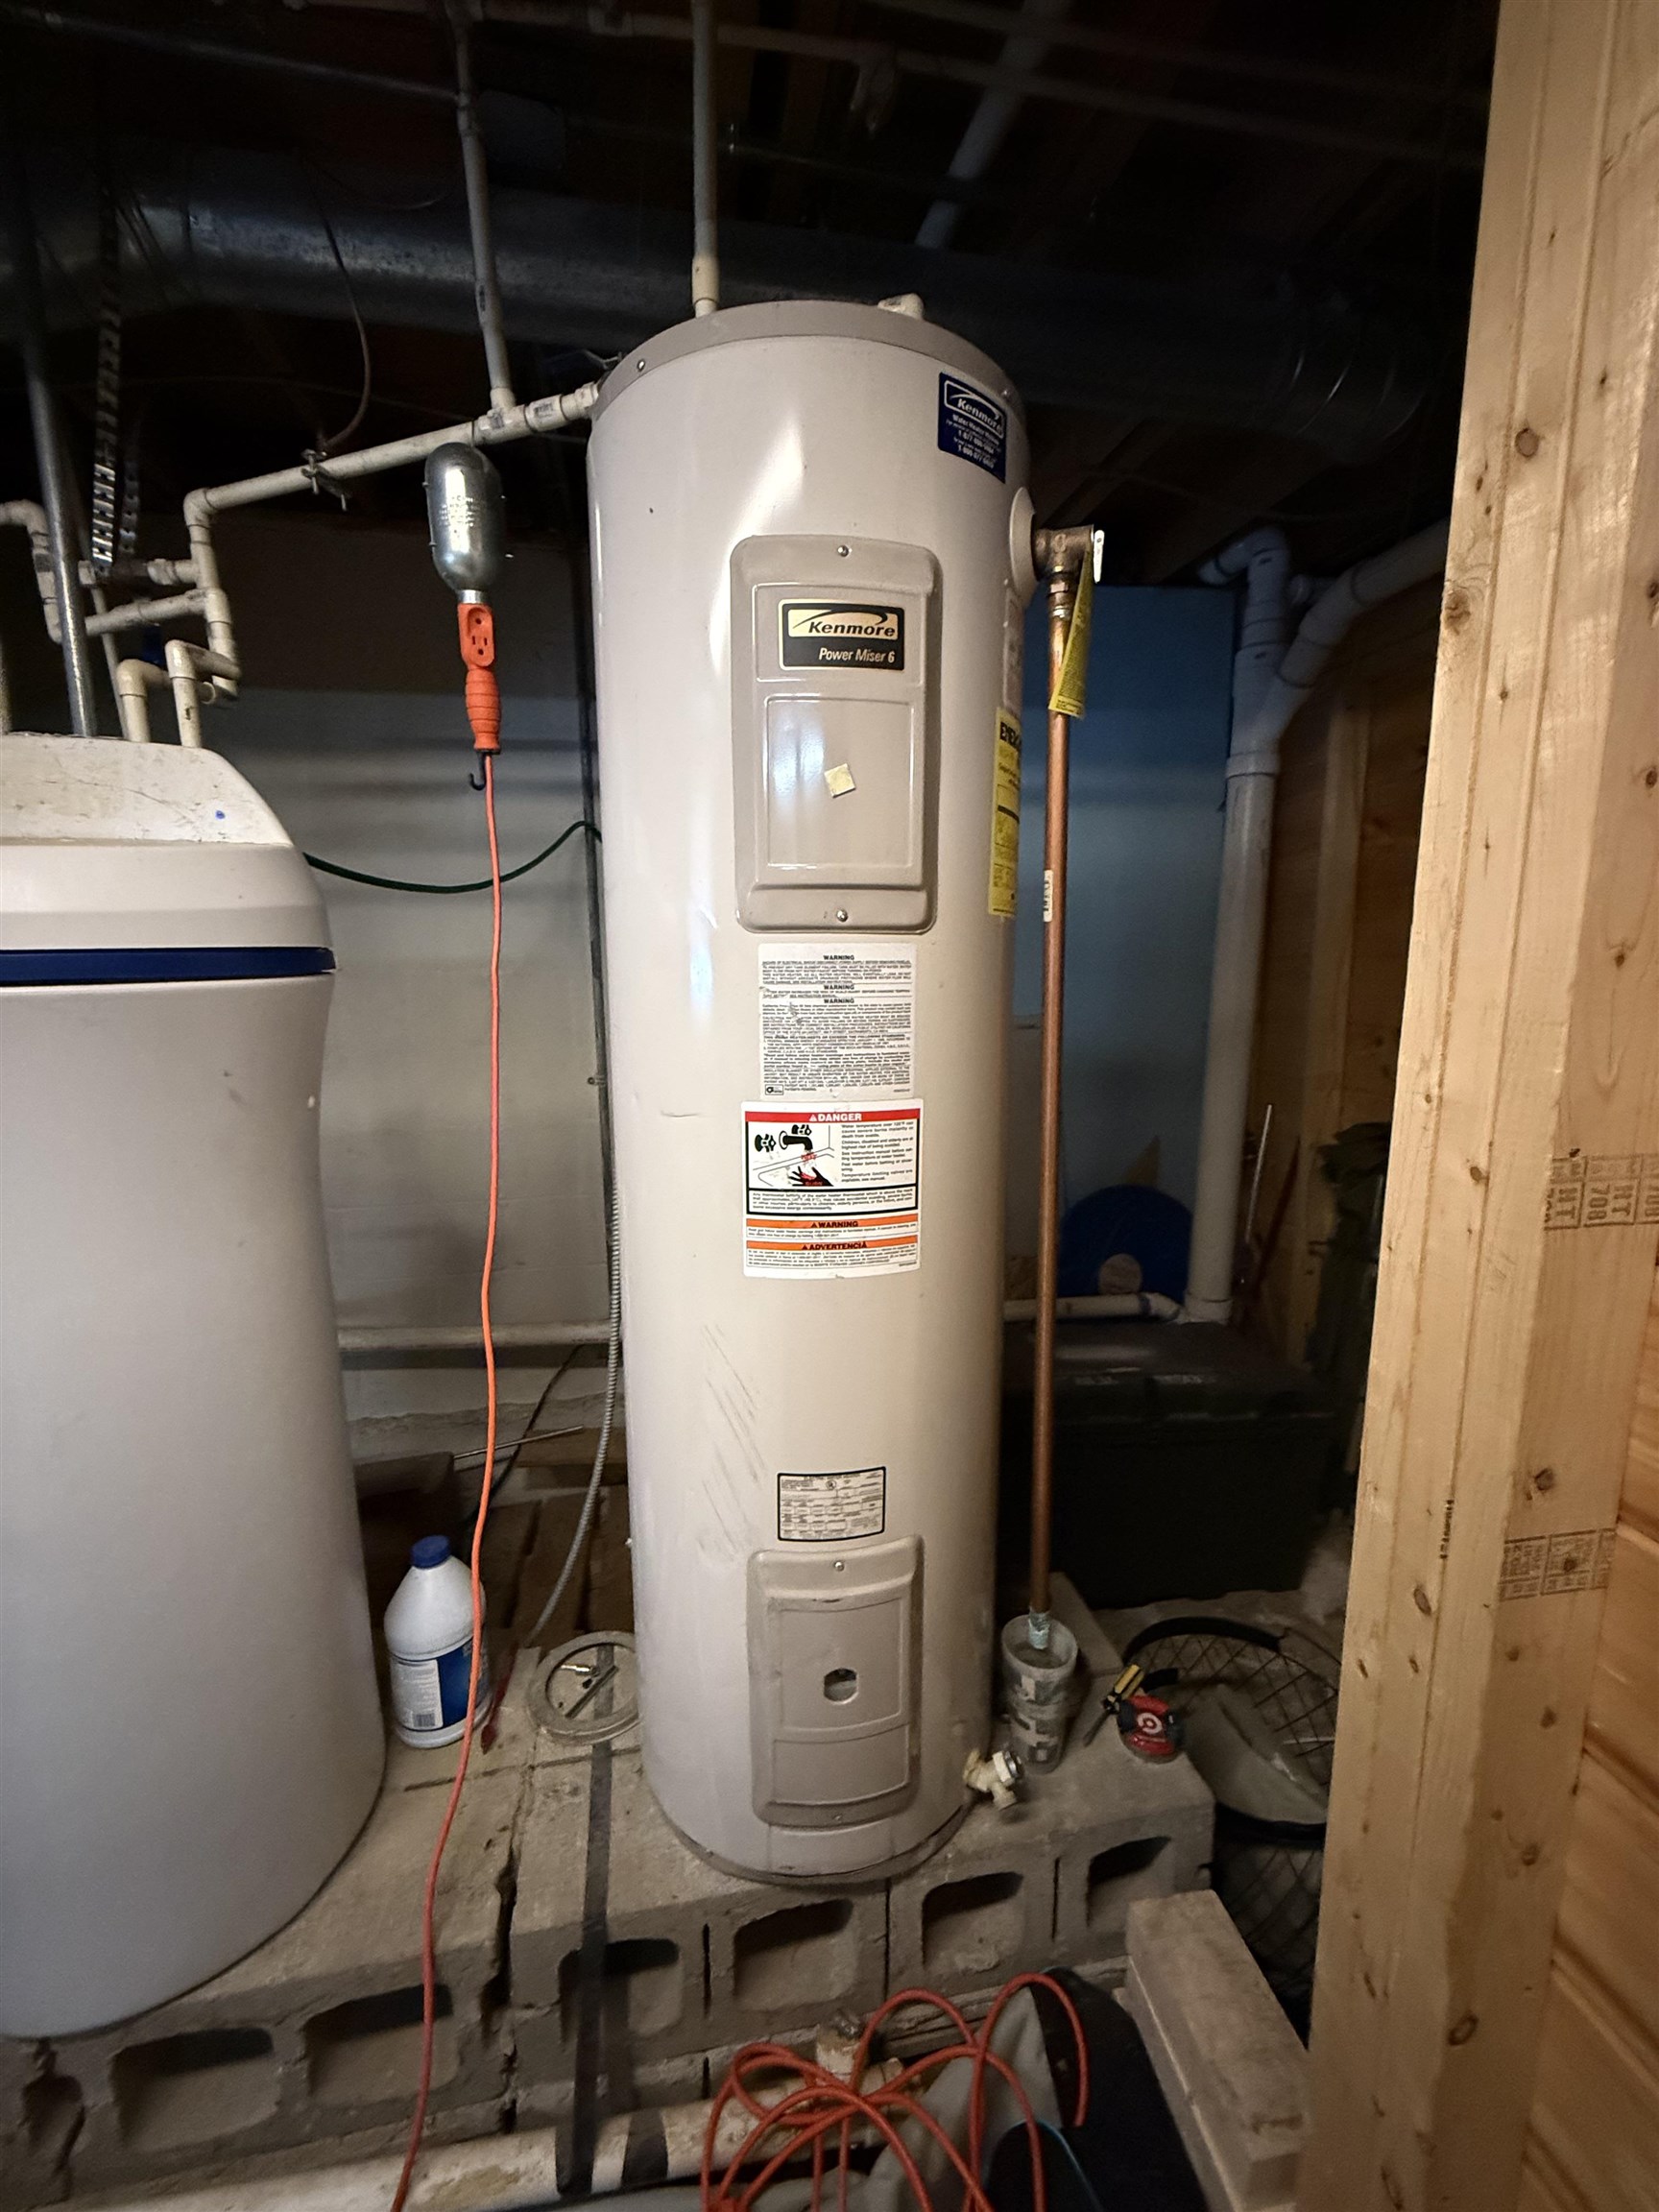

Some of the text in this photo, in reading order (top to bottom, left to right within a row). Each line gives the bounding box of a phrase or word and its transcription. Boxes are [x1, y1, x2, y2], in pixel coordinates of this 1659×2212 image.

[957, 398, 1001, 432] Kenmore
[809, 621, 895, 637] Kenmore
[819, 647, 896, 663] Power Miser 6
[809, 1241, 867, 1250] ADVERTENCIA
